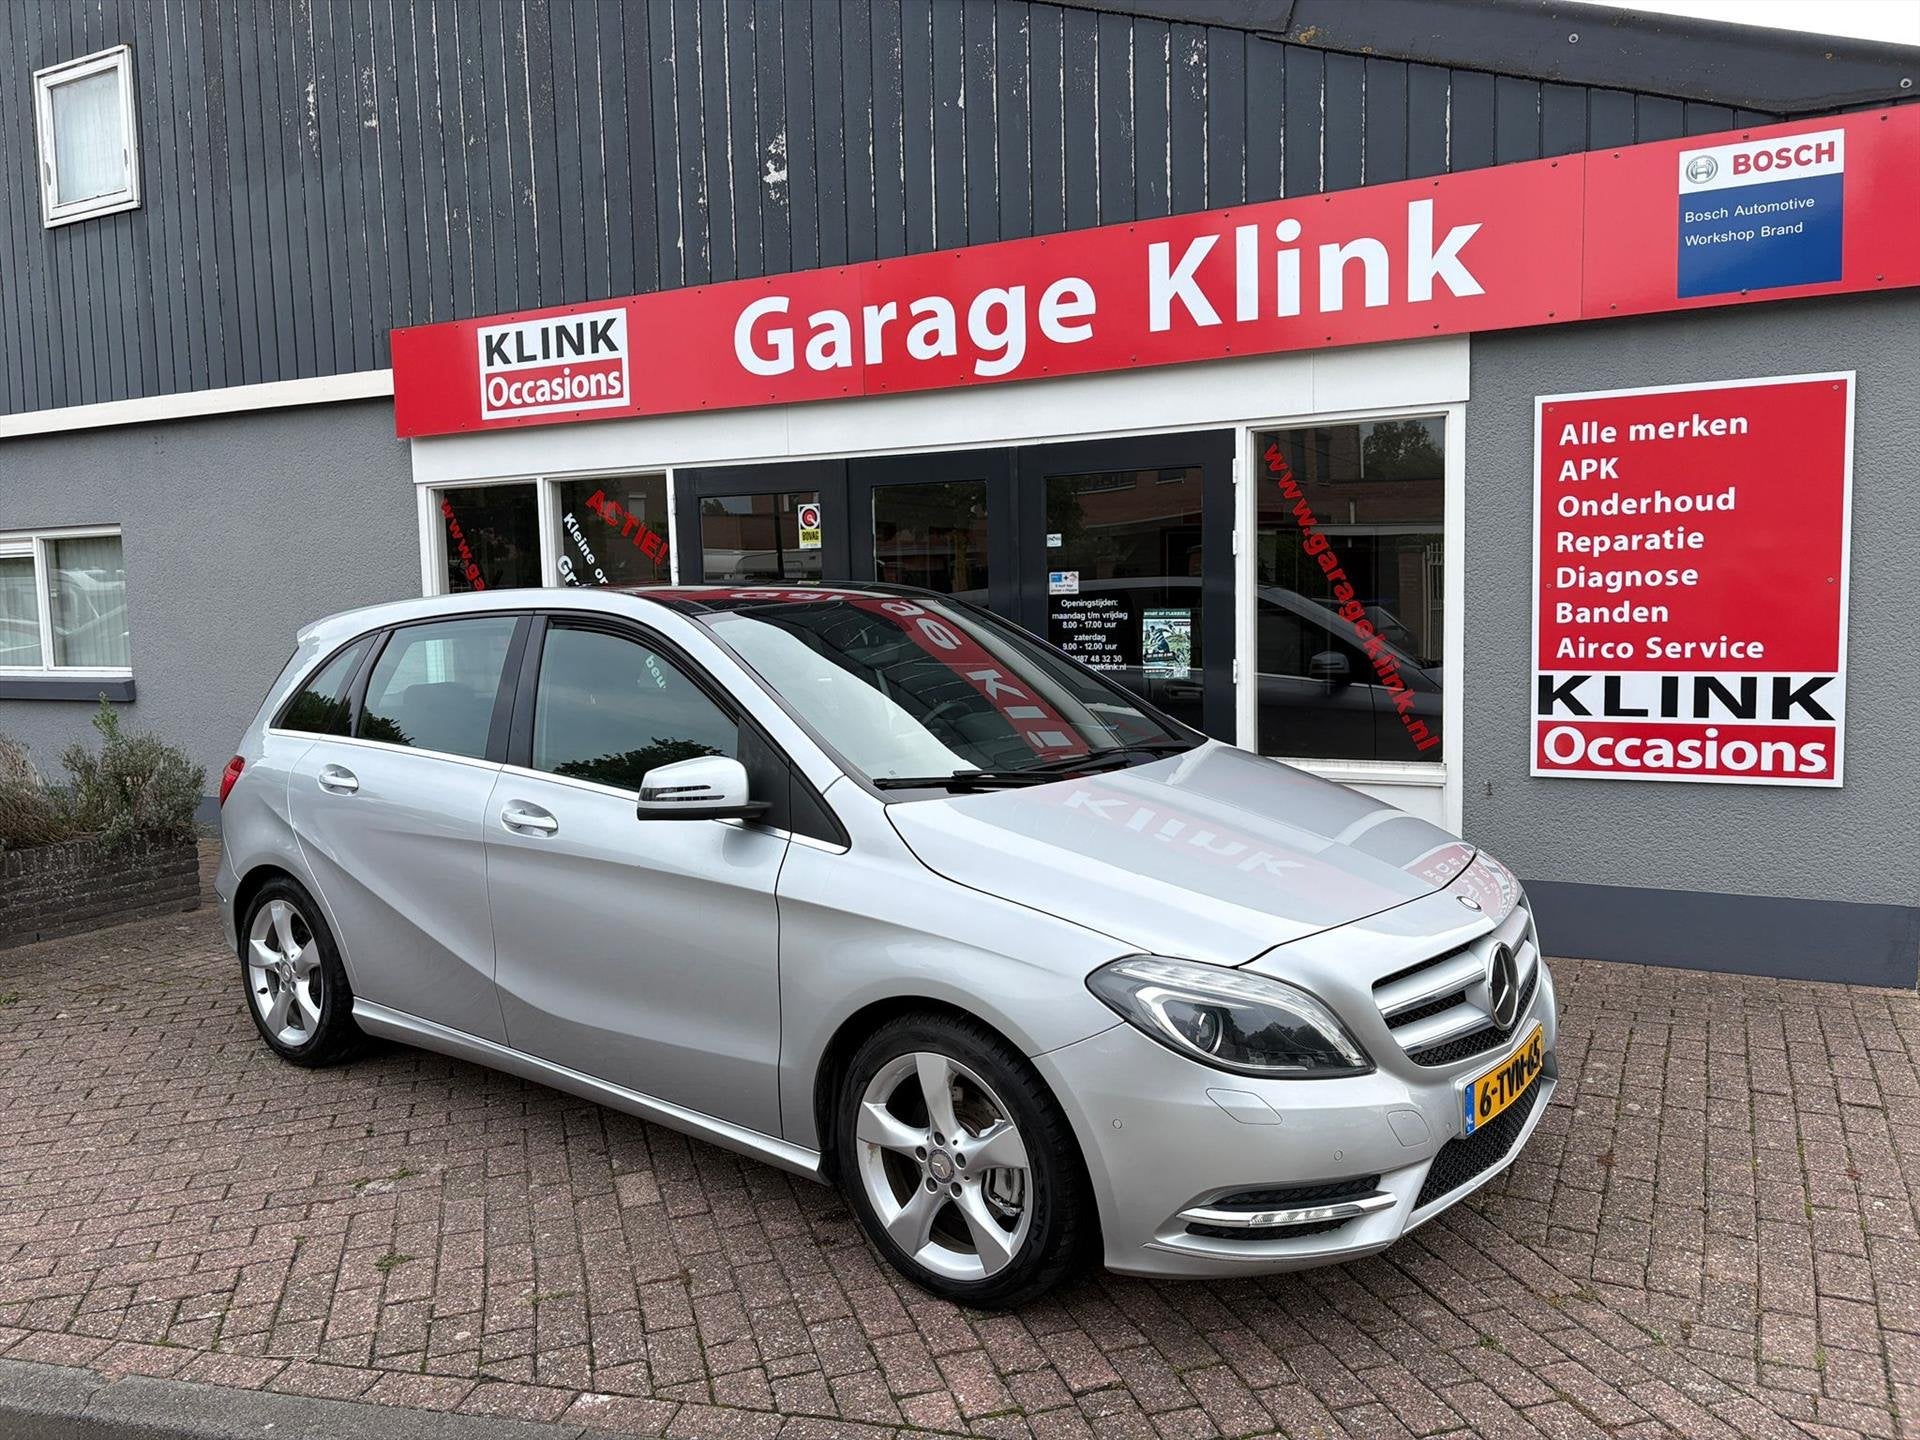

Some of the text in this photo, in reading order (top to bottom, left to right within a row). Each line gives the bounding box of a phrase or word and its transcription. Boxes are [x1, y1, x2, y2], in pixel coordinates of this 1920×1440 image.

[1733, 141, 1835, 176] BOSCH
[1685, 197, 1815, 223] Bosch Automotive
[1685, 222, 1803, 247] Workshop Brand
[733, 198, 1486, 377] Garage Klink
[485, 317, 619, 367] KLINK
[487, 368, 622, 408] Occasions
[1558, 414, 1749, 446] Alle merken
[1558, 457, 1619, 483] APK
[1557, 487, 1736, 517] Onderhoud
[563, 512, 595, 565] Kleine
[585, 489, 669, 566] ACTIE!
[1556, 527, 1705, 557] Reparatie
[1556, 566, 1699, 593] Diagnose
[1061, 598, 1119, 609] Openingstijden:
[1263, 443, 1441, 751] www.garageklink.nl
[1051, 612, 1086, 621] maandag
[1102, 611, 1128, 621] vrijdag
[1062, 621, 1078, 629] 8.00
[1084, 621, 1102, 629] 17.00
[1556, 601, 1669, 624] Banden
[1073, 633, 1106, 643] zaterdag
[1084, 642, 1103, 650] 12.00
[1556, 635, 1764, 659] Airco Service
[645, 654, 667, 689] beu
[1537, 674, 1836, 721] KLINK
[1543, 725, 1827, 773] Occasions
[1479, 1035, 1540, 1117] 6-TVN-65
